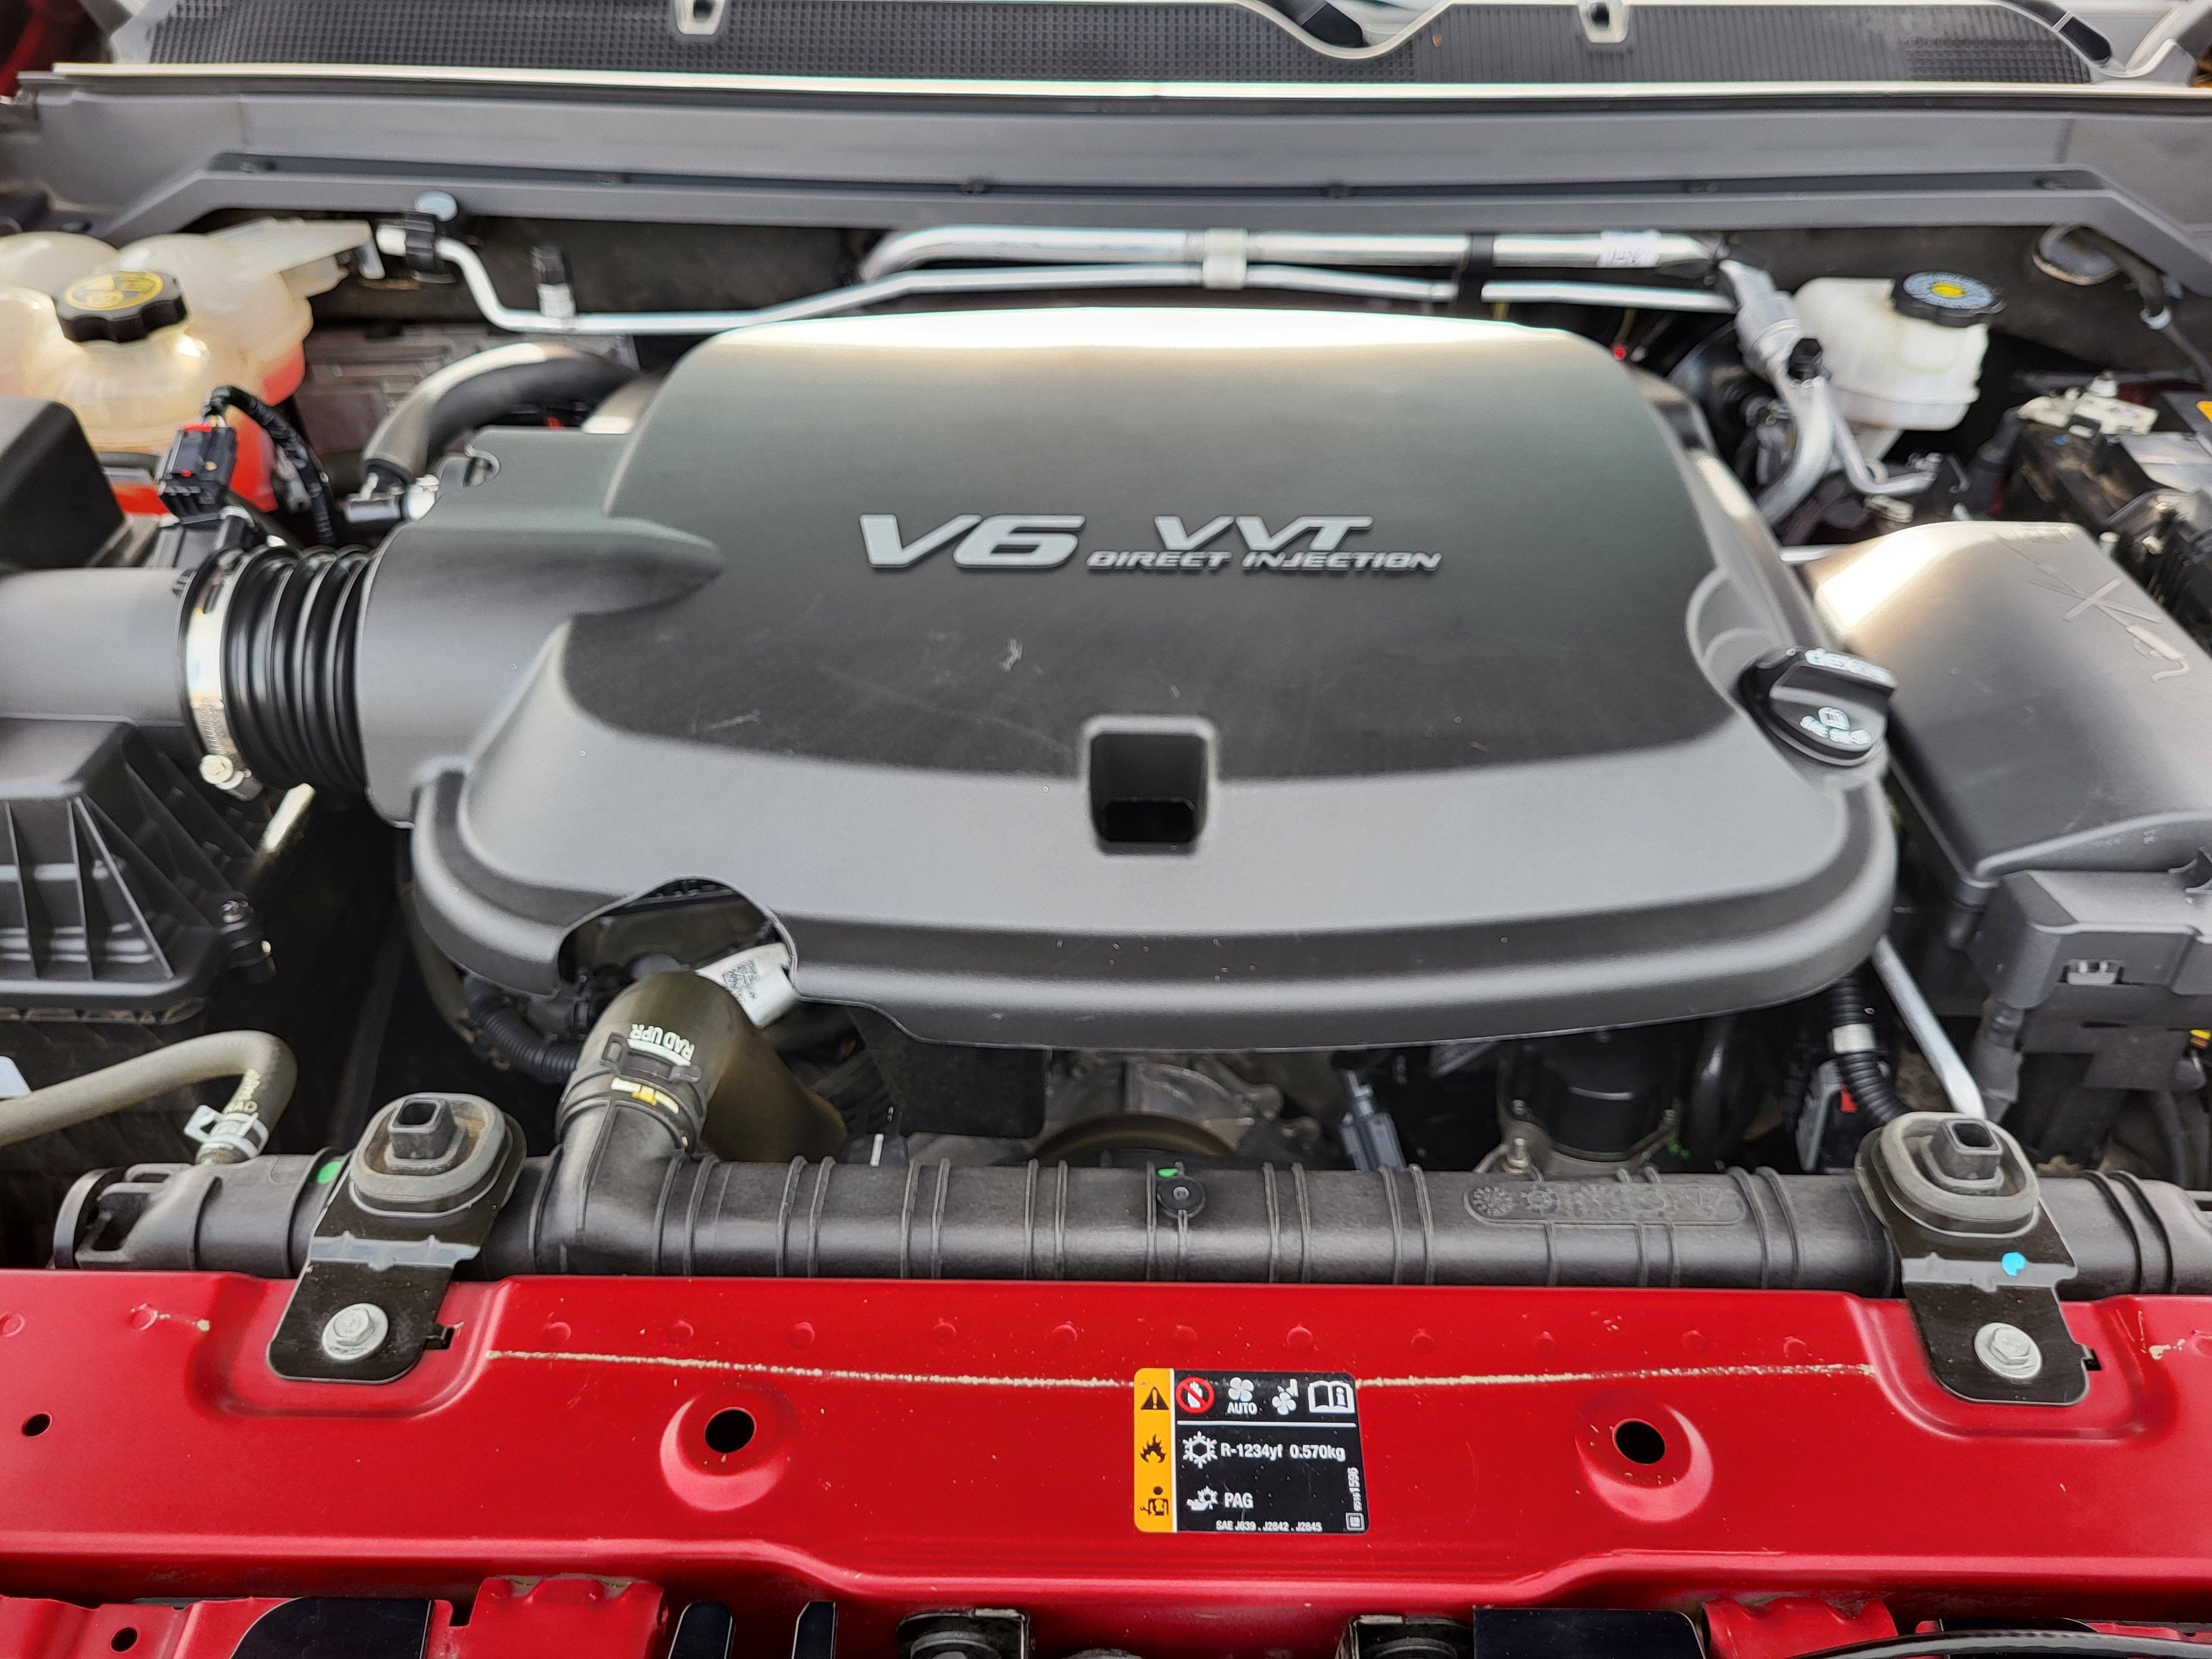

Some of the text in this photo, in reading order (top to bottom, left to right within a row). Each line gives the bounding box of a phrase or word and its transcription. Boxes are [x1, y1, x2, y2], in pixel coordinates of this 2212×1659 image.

[859, 514, 1086, 567] V6
[1154, 515, 1374, 551] VVT
[1086, 551, 1443, 571] DIRECT INJECTION
[629, 1024, 695, 1061] RAD UPR
[1227, 1402, 1258, 1416] AUTO
[1220, 1442, 1347, 1462] R-1234yf 0.570kg
[1224, 1492, 1254, 1509] PAG
[1215, 1520, 1234, 1531] SAE
